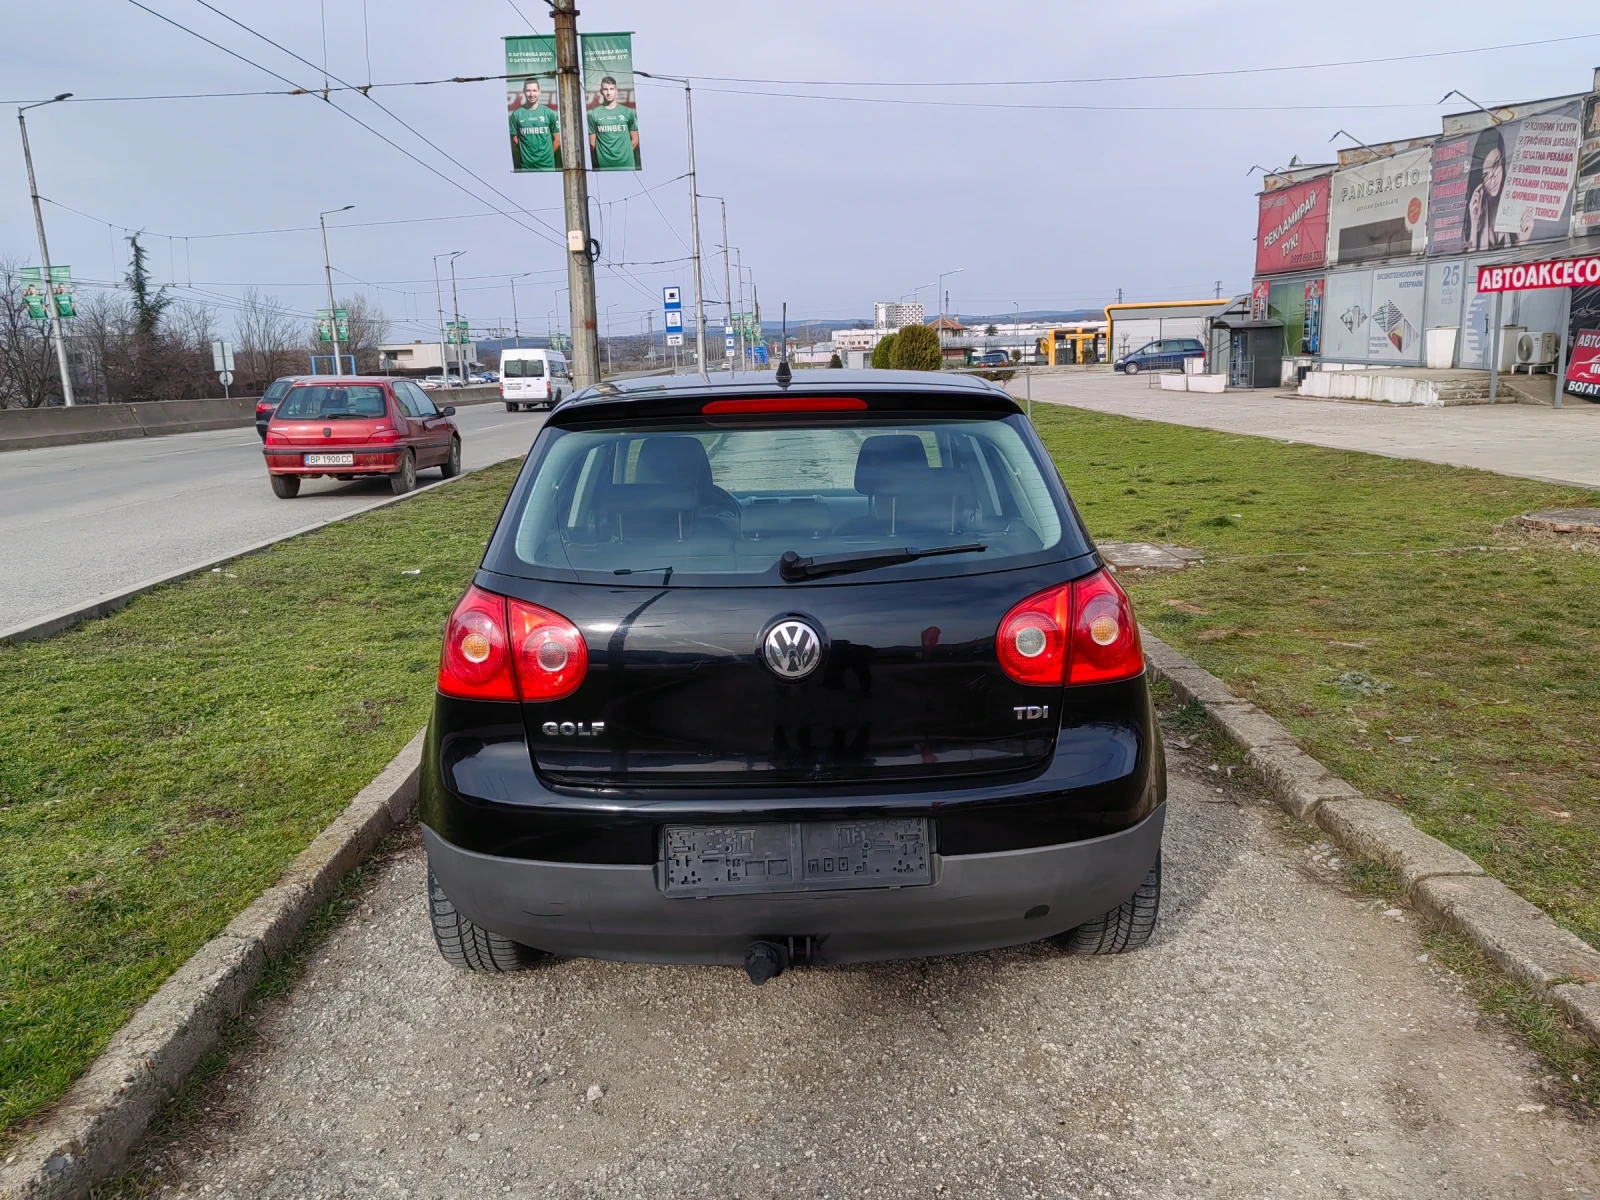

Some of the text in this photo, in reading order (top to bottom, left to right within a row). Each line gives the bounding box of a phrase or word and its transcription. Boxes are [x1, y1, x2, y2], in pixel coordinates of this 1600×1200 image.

[520, 126, 549, 134] WINBET
[598, 124, 627, 132] WINBET
[1342, 169, 1419, 202] PANCRACIO
[1374, 198, 1399, 208] CHOCOLATE
[1264, 189, 1316, 249] РЕКЛАМИРАЙ
[1282, 233, 1298, 257] ТУК!
[1377, 270, 1424, 280] ВИСОКОТЕХНОЛОГИЧНИ
[1442, 265, 1460, 287] 25
[1480, 258, 1600, 290] АВТОАКСЕСО
[1398, 280, 1423, 288] МАТЕРИАЛИ
[322, 455, 340, 463] 1900
[341, 455, 351, 463] CC
[765, 621, 820, 677] VW
[1013, 705, 1049, 721] TDI
[542, 721, 605, 736] GOLF
